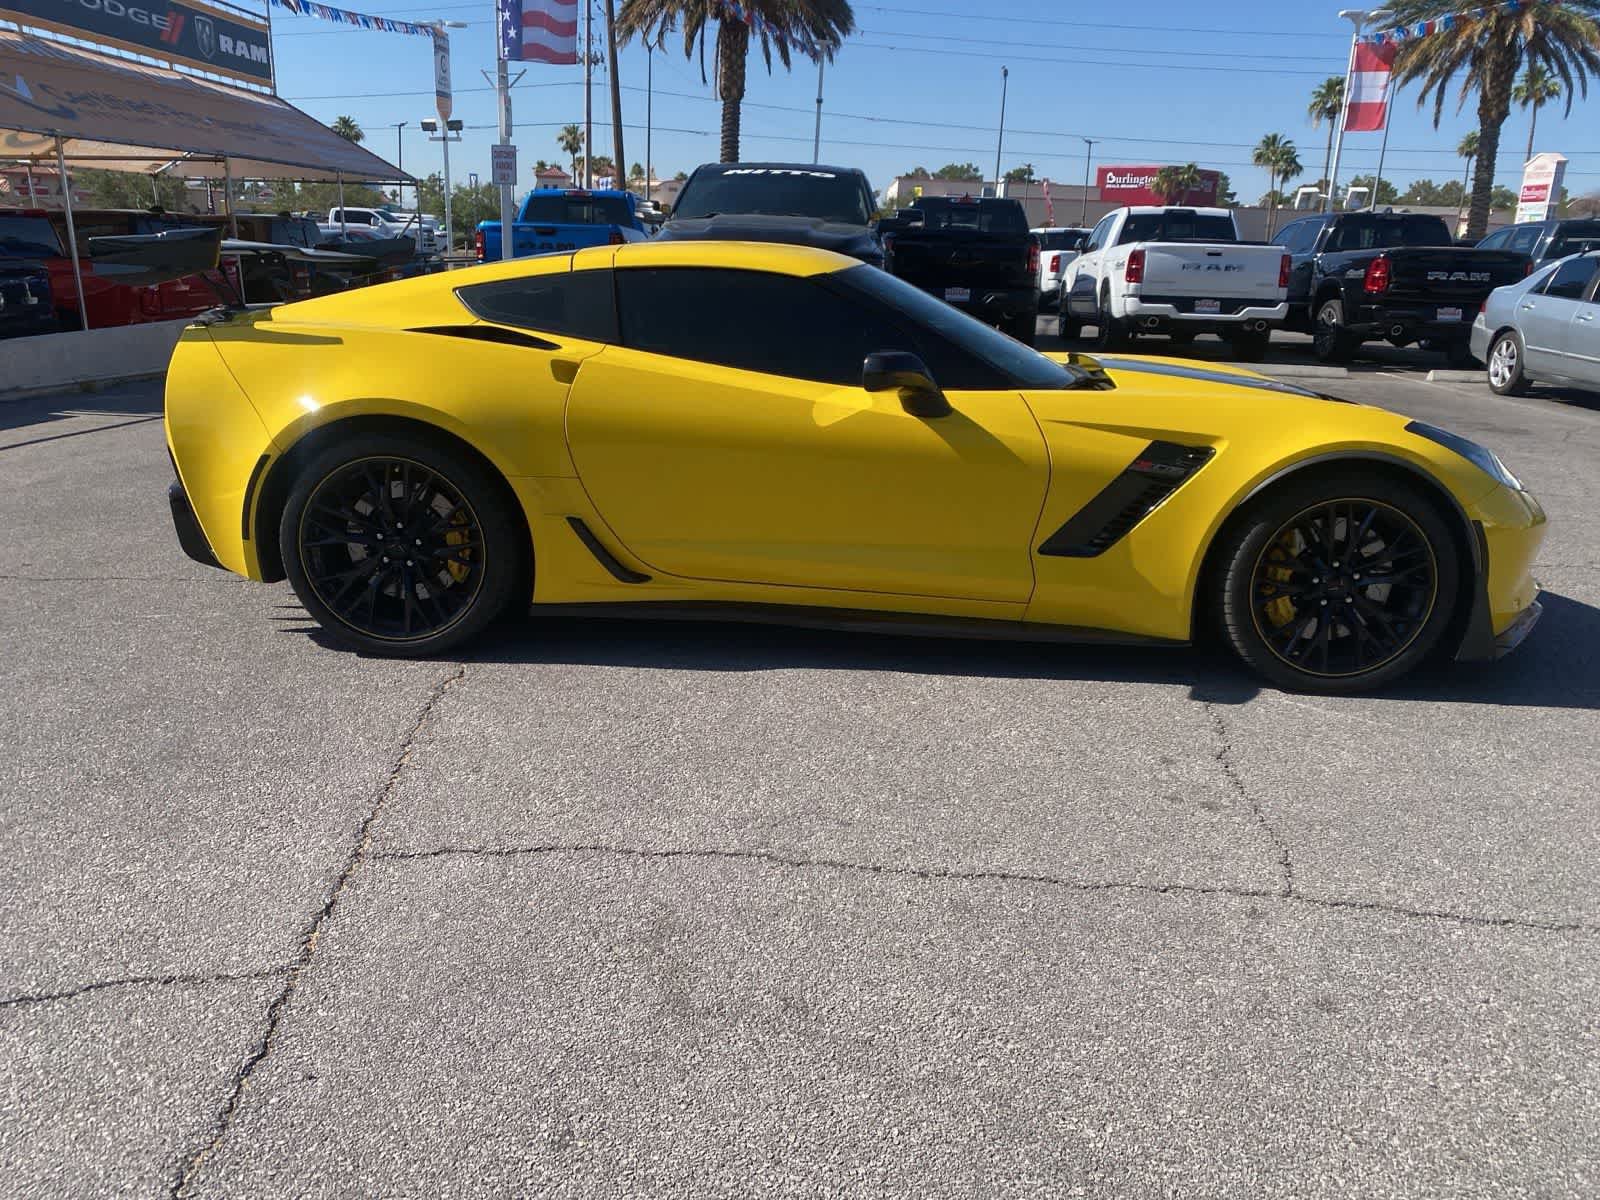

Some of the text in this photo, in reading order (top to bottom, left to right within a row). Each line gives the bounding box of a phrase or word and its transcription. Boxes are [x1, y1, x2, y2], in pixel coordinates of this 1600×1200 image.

[79, 0, 172, 32] ODGE
[219, 34, 268, 64] RAM
[723, 169, 836, 178] NITTO
[1182, 263, 1246, 273] RAM
[1427, 271, 1491, 281] RAM
